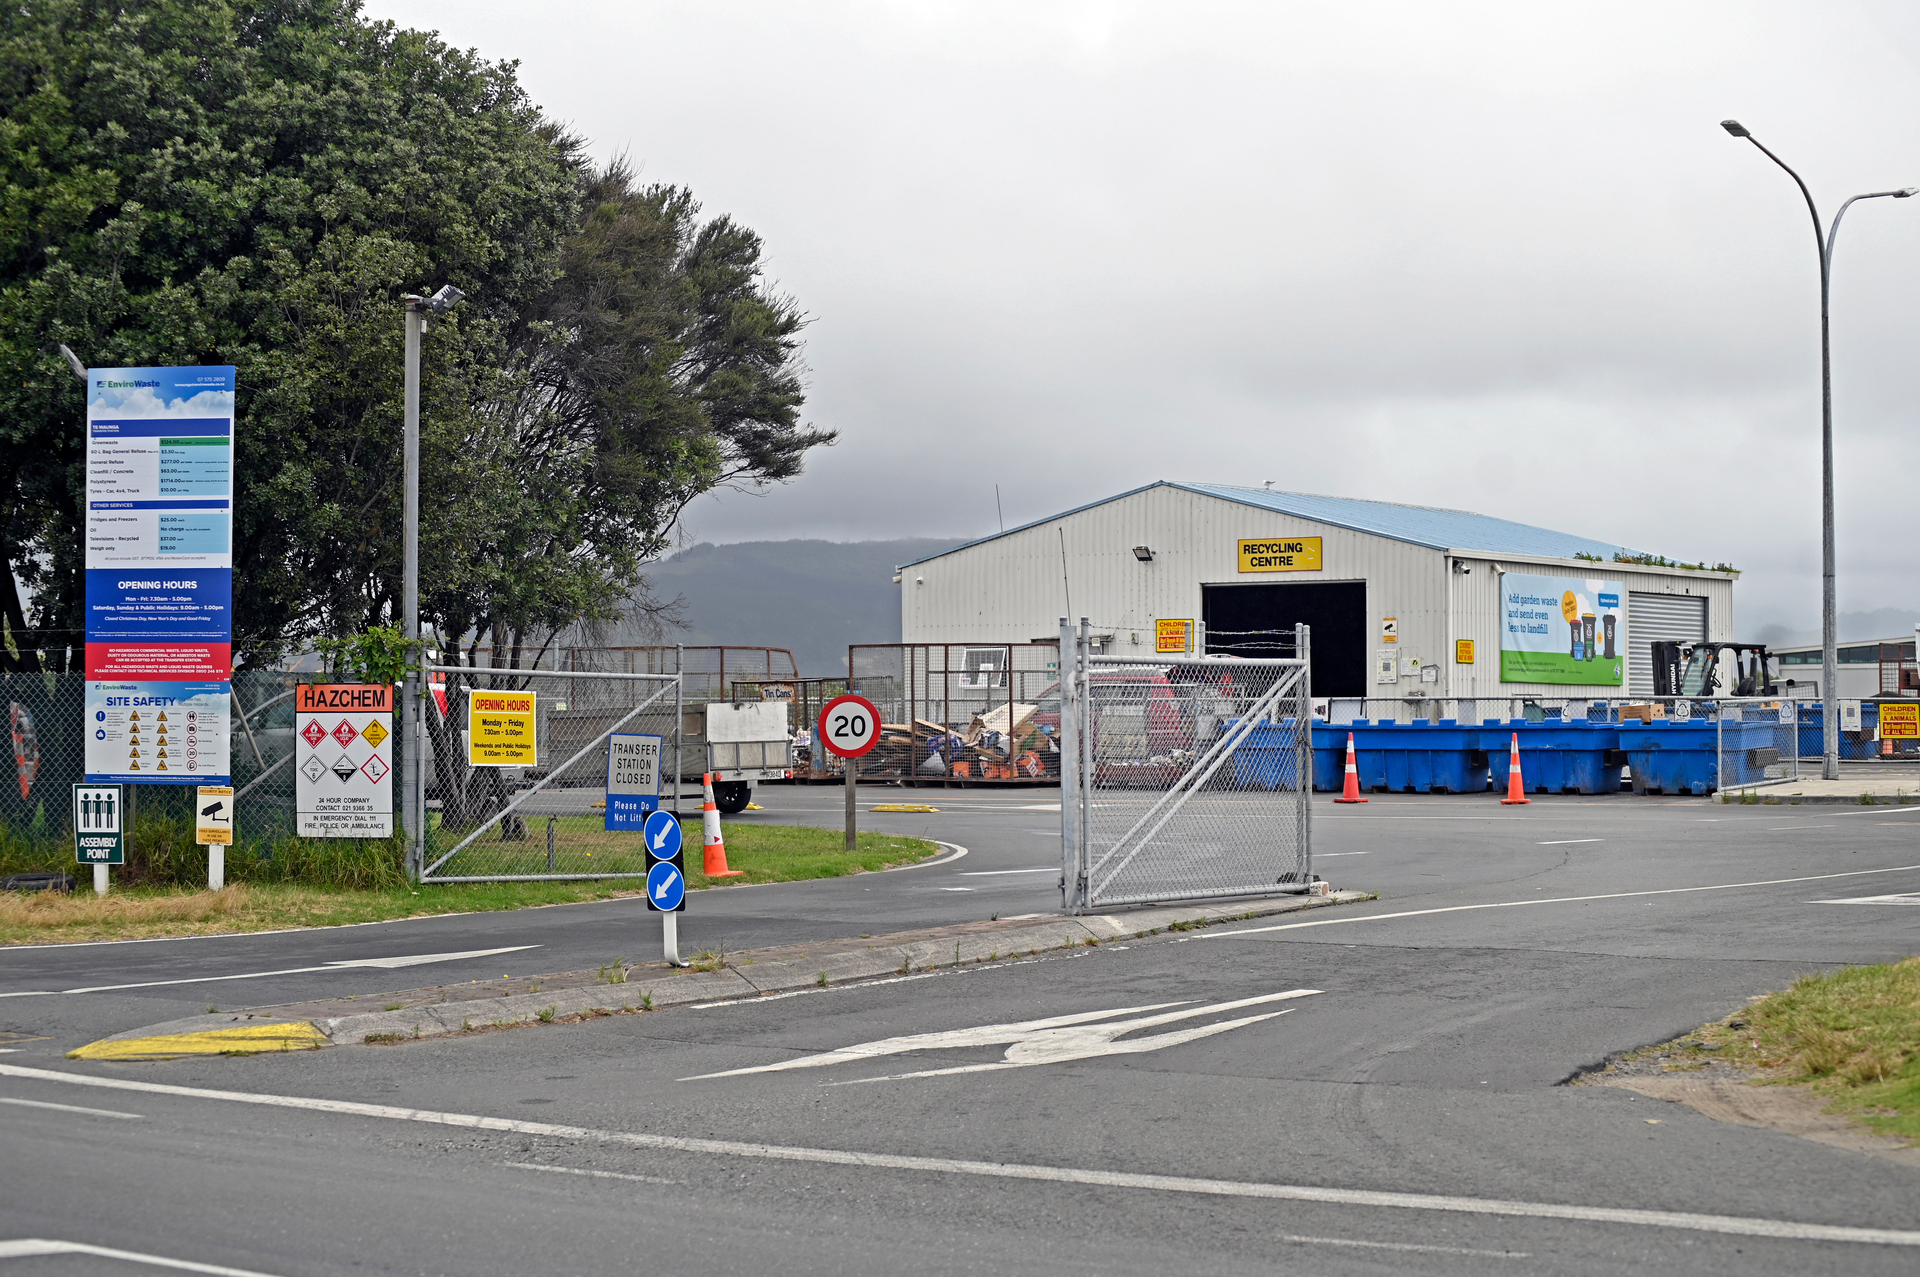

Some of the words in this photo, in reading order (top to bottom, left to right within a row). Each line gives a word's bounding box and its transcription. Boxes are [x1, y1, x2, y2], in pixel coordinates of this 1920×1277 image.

[108, 380, 160, 388] EnviroWaste
[1243, 542, 1303, 554] RECYCLING
[1250, 556, 1293, 567] CENTRE
[118, 581, 161, 589] OPENING
[163, 581, 198, 589] HOURS
[1509, 594, 1519, 603] Add
[1520, 595, 1541, 606] garden
[1541, 597, 1558, 606] waste
[1508, 609, 1519, 619] and
[1520, 610, 1534, 619] send
[1535, 612, 1549, 620] even
[1508, 622, 1519, 632] less
[1520, 624, 1527, 633] to
[1527, 624, 1548, 634] landfill
[304, 690, 385, 707] HAZCHEM
[765, 689, 774, 698] Tin
[776, 689, 791, 698] Cans
[106, 697, 130, 706] SITE
[133, 697, 176, 706] SAFETY
[475, 699, 505, 710] OPENING
[507, 700, 530, 711] HOURS
[482, 719, 502, 727] Monday
[508, 719, 524, 728] Friday
[834, 715, 866, 737] 20
[505, 729, 523, 737] 5.00pm
[613, 743, 657, 755] TRANSFER
[617, 758, 651, 769] STATION
[616, 773, 651, 784] CLOSED
[614, 801, 637, 809] Please
[641, 801, 650, 810] Do
[614, 814, 626, 822] Not
[630, 814, 643, 822] Litt
[79, 837, 117, 848] ASSEMBLY
[86, 849, 110, 859] POINT
